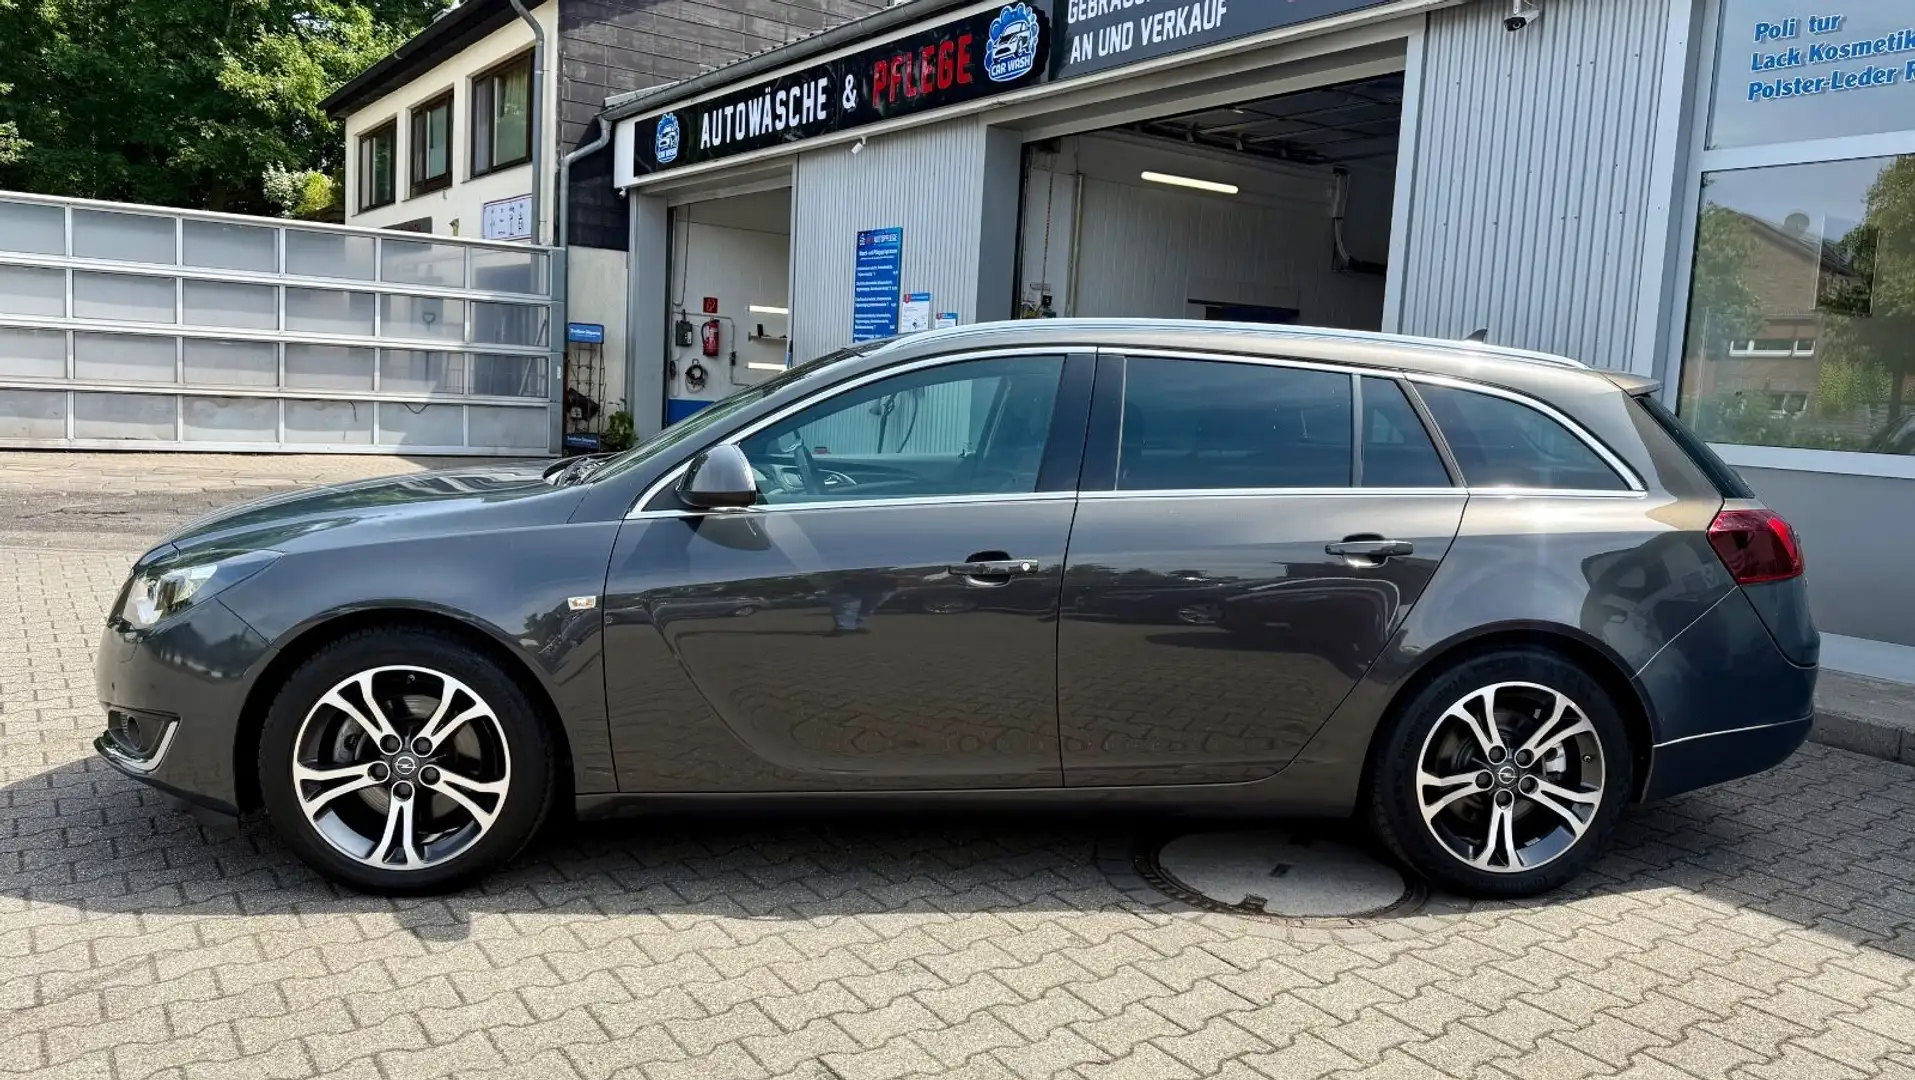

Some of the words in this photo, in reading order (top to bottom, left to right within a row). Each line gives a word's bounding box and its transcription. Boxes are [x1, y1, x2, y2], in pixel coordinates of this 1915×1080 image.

[1068, 0, 1151, 24] GEBRA
[1070, 31, 1094, 65] AN
[1098, 21, 1134, 57] UND
[1140, 0, 1227, 46] VERKAUF
[1753, 17, 1797, 42] Poli
[1808, 14, 1842, 34] tur
[991, 62, 1007, 76] CAR
[1007, 55, 1031, 71] WASH
[1750, 46, 1801, 72] Lack
[700, 77, 828, 149] AUTOWÄSCHE
[842, 73, 857, 109] &
[872, 33, 973, 109] PFLEGE
[1747, 64, 1898, 102] Polster-Leder
